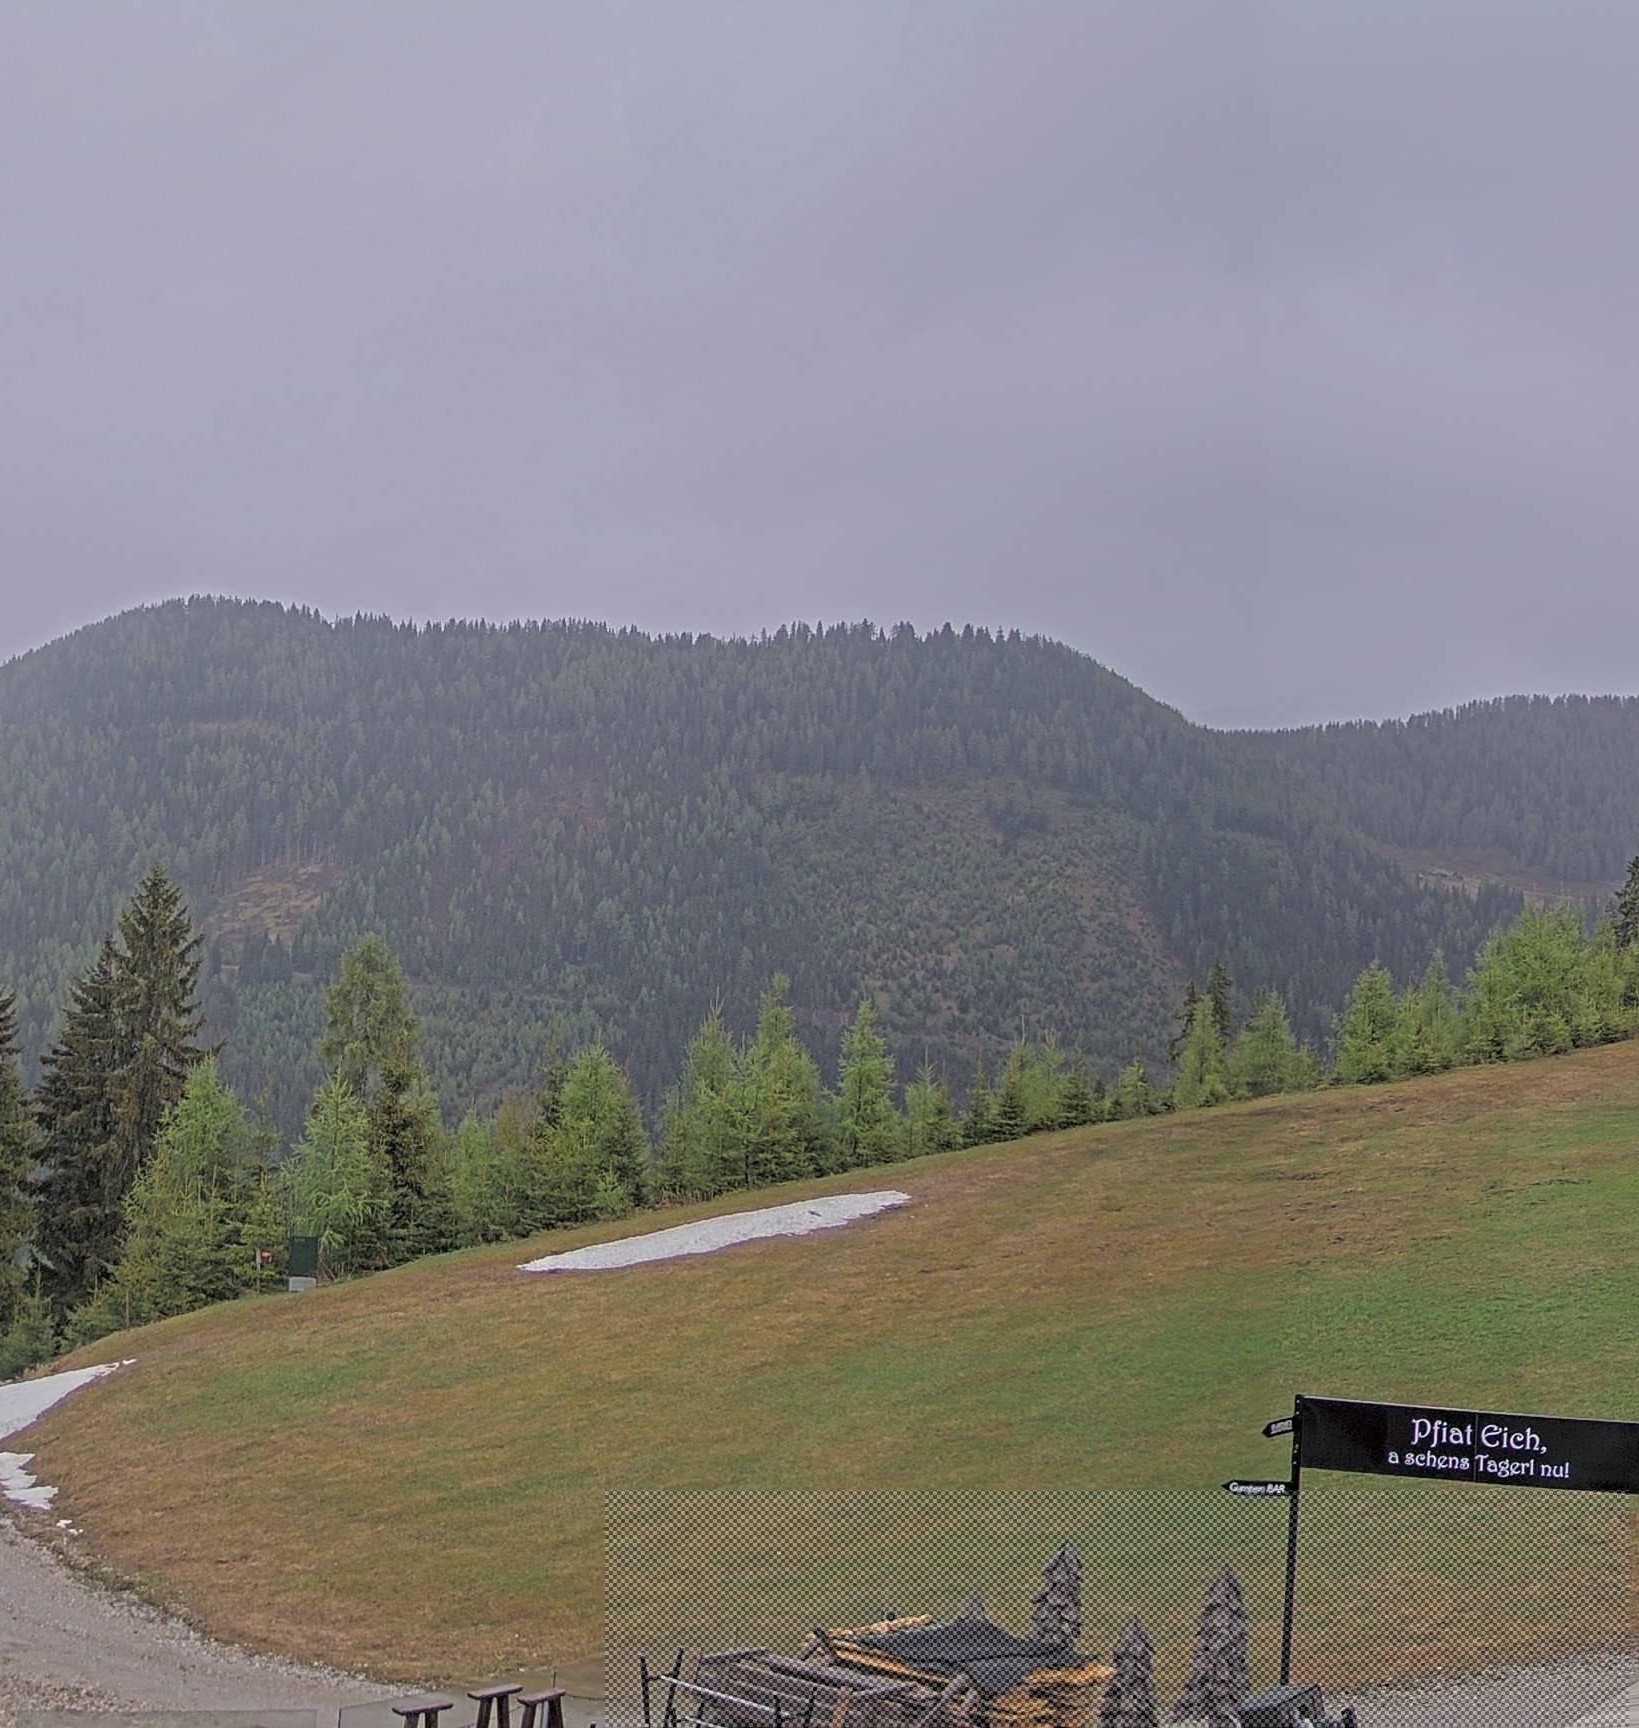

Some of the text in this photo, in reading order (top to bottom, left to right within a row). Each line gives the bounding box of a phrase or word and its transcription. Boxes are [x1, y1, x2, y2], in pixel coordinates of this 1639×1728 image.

[1411, 1418, 1547, 1454] Pfiat Eich,
[1388, 1450, 1570, 1478] a schens Tagerl nu!
[1266, 1483, 1286, 1494] BAR
